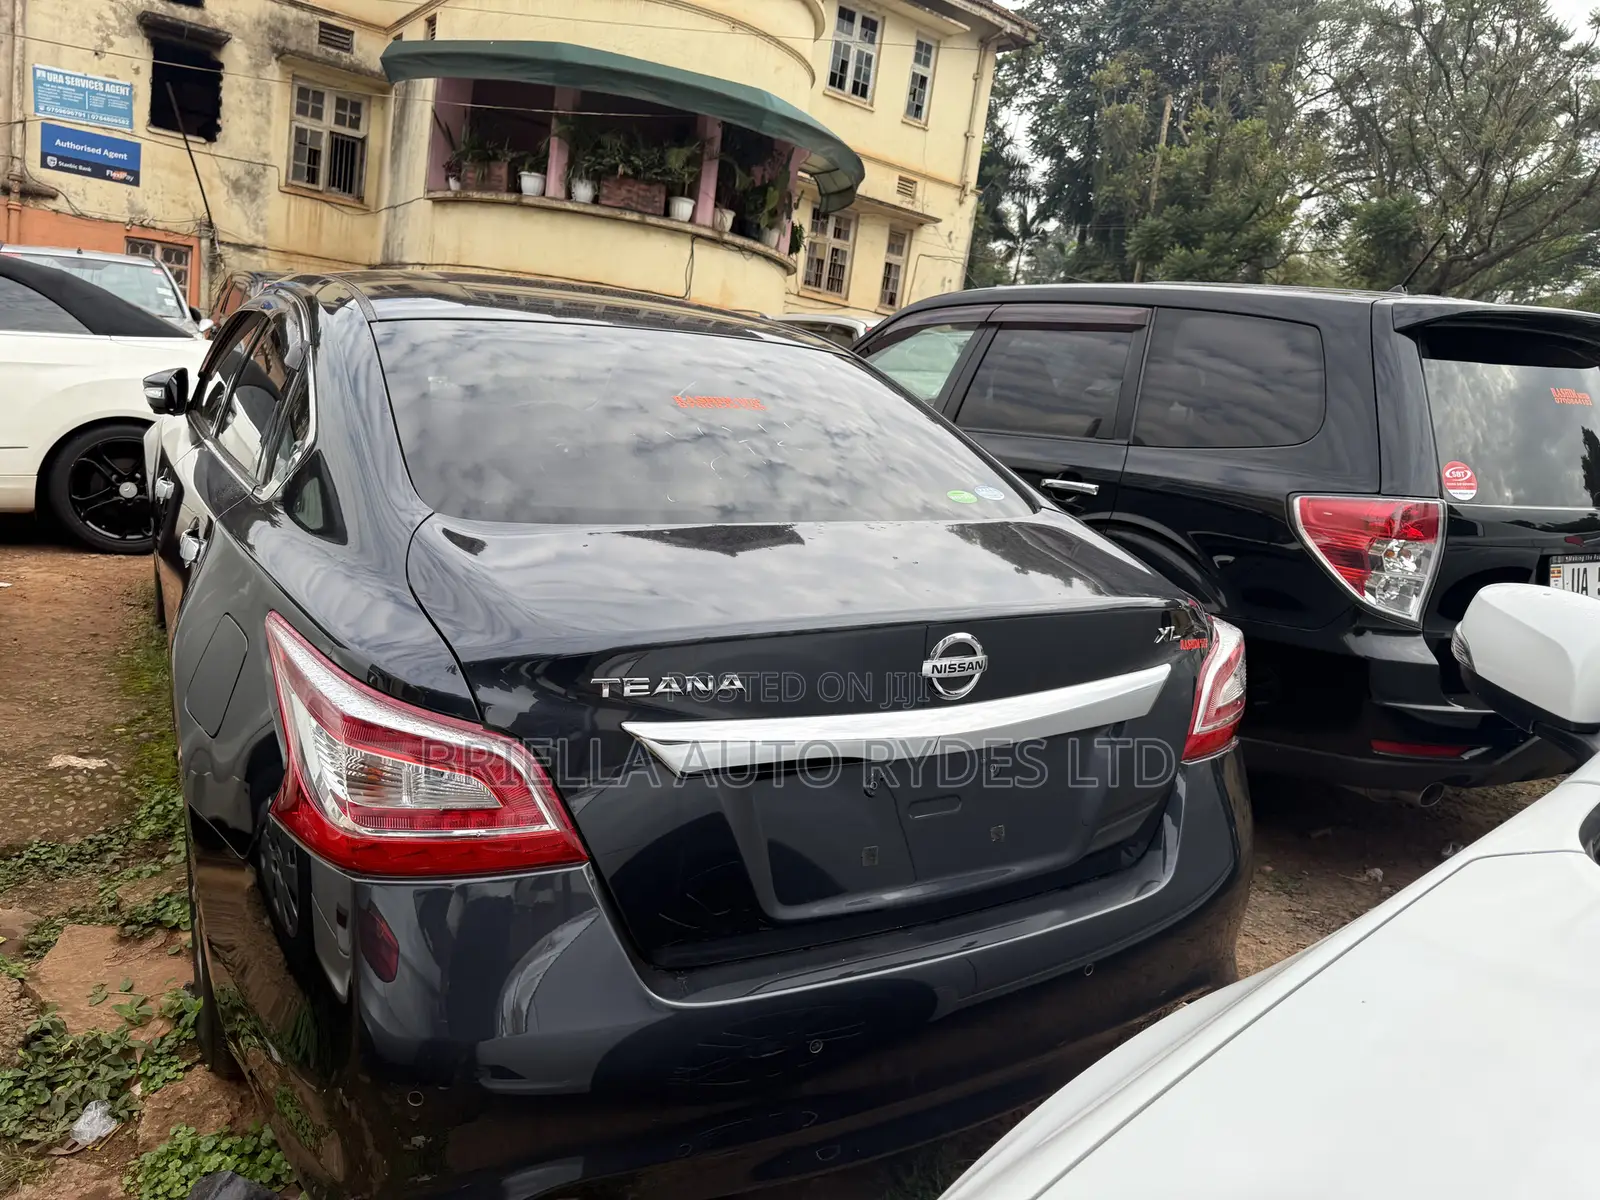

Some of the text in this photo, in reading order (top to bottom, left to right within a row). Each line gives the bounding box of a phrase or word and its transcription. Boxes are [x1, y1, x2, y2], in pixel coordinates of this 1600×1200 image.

[47, 72, 64, 85] URA
[65, 75, 104, 92] SERVICES
[104, 83, 130, 96] AGENT
[55, 139, 128, 160] Authorised Agent
[58, 161, 92, 173] Stanbic Bank
[931, 660, 984, 675] NISSAN
[590, 674, 747, 698] TEANA
